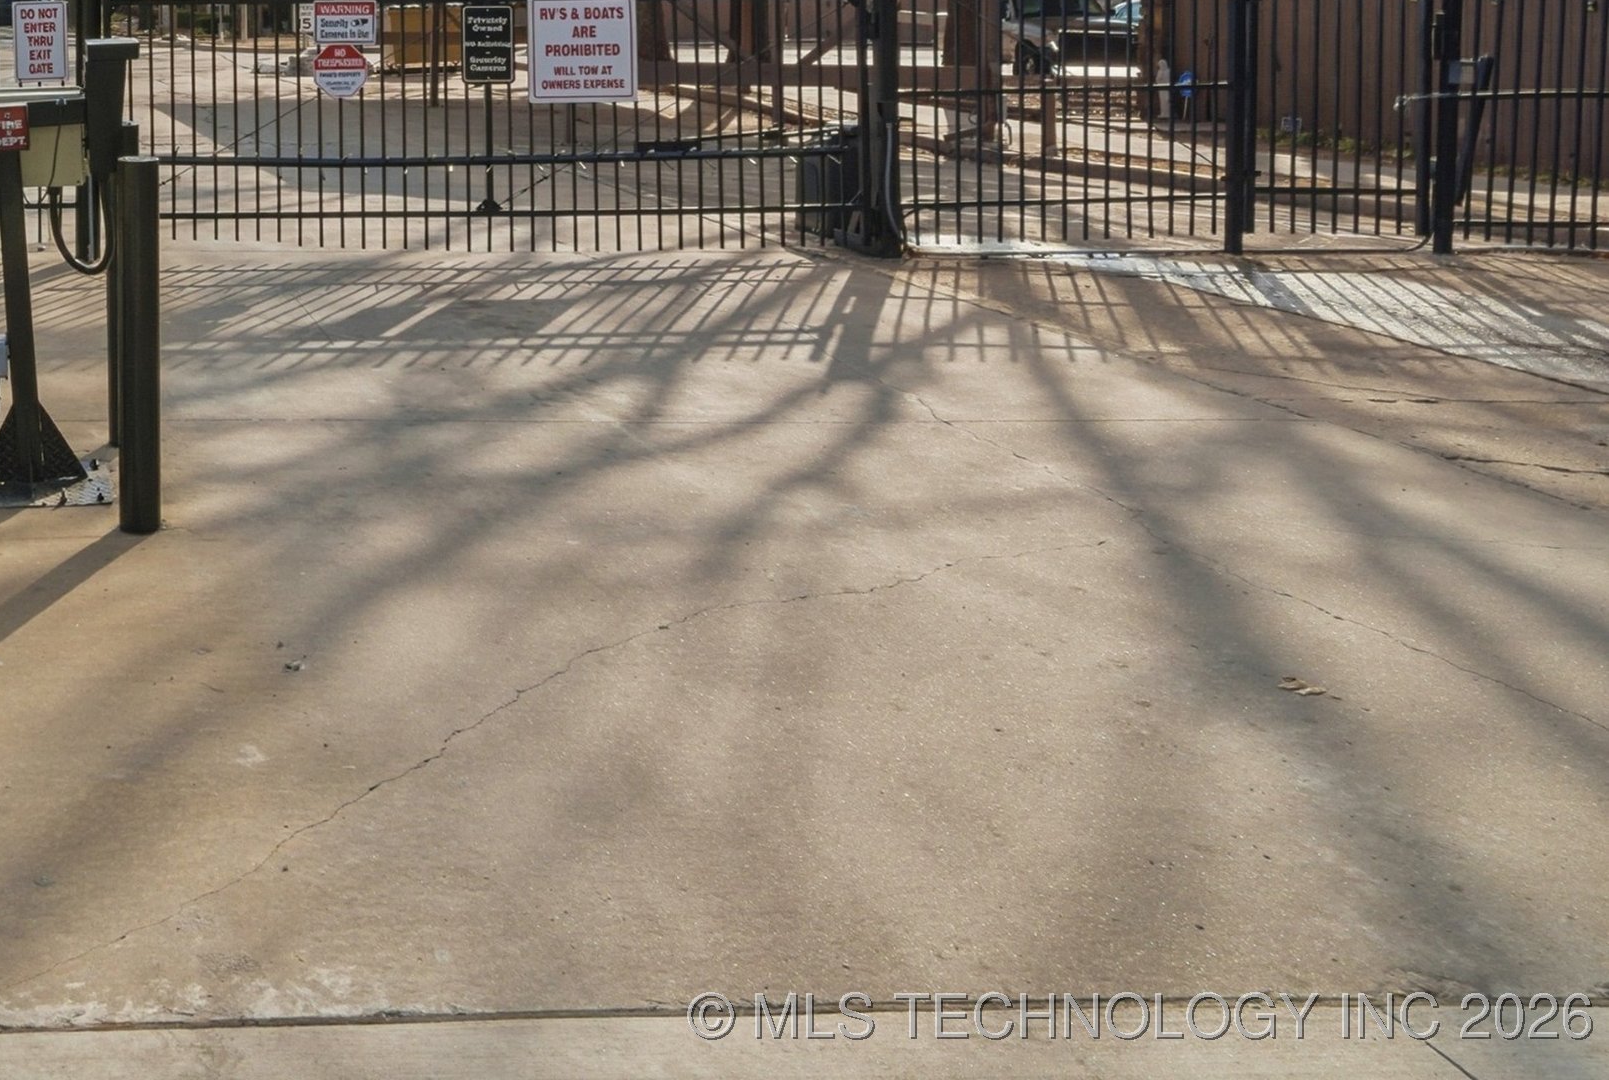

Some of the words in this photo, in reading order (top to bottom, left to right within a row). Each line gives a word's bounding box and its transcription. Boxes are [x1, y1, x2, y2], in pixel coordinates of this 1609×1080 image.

[20, 8, 35, 20] DO
[38, 8, 59, 18] NOT
[320, 4, 370, 14] WARNING
[539, 7, 568, 20] RV'S
[570, 8, 580, 20] &
[583, 6, 625, 20] BOATS
[23, 22, 57, 34] ENTER
[320, 18, 348, 29] Security
[472, 24, 503, 32] Owned
[320, 29, 348, 39] Cameras
[572, 25, 597, 38] ARE
[27, 36, 54, 47] THRU
[29, 49, 52, 60] EXIT
[333, 48, 347, 57] NO
[545, 43, 621, 57] PROHIBITED
[29, 62, 54, 74] GATE
[553, 66, 576, 76] WILL
[578, 65, 599, 75] TOW
[601, 65, 613, 75] AT
[541, 80, 582, 90] OWNERS
[583, 79, 625, 89] EXPENSE
